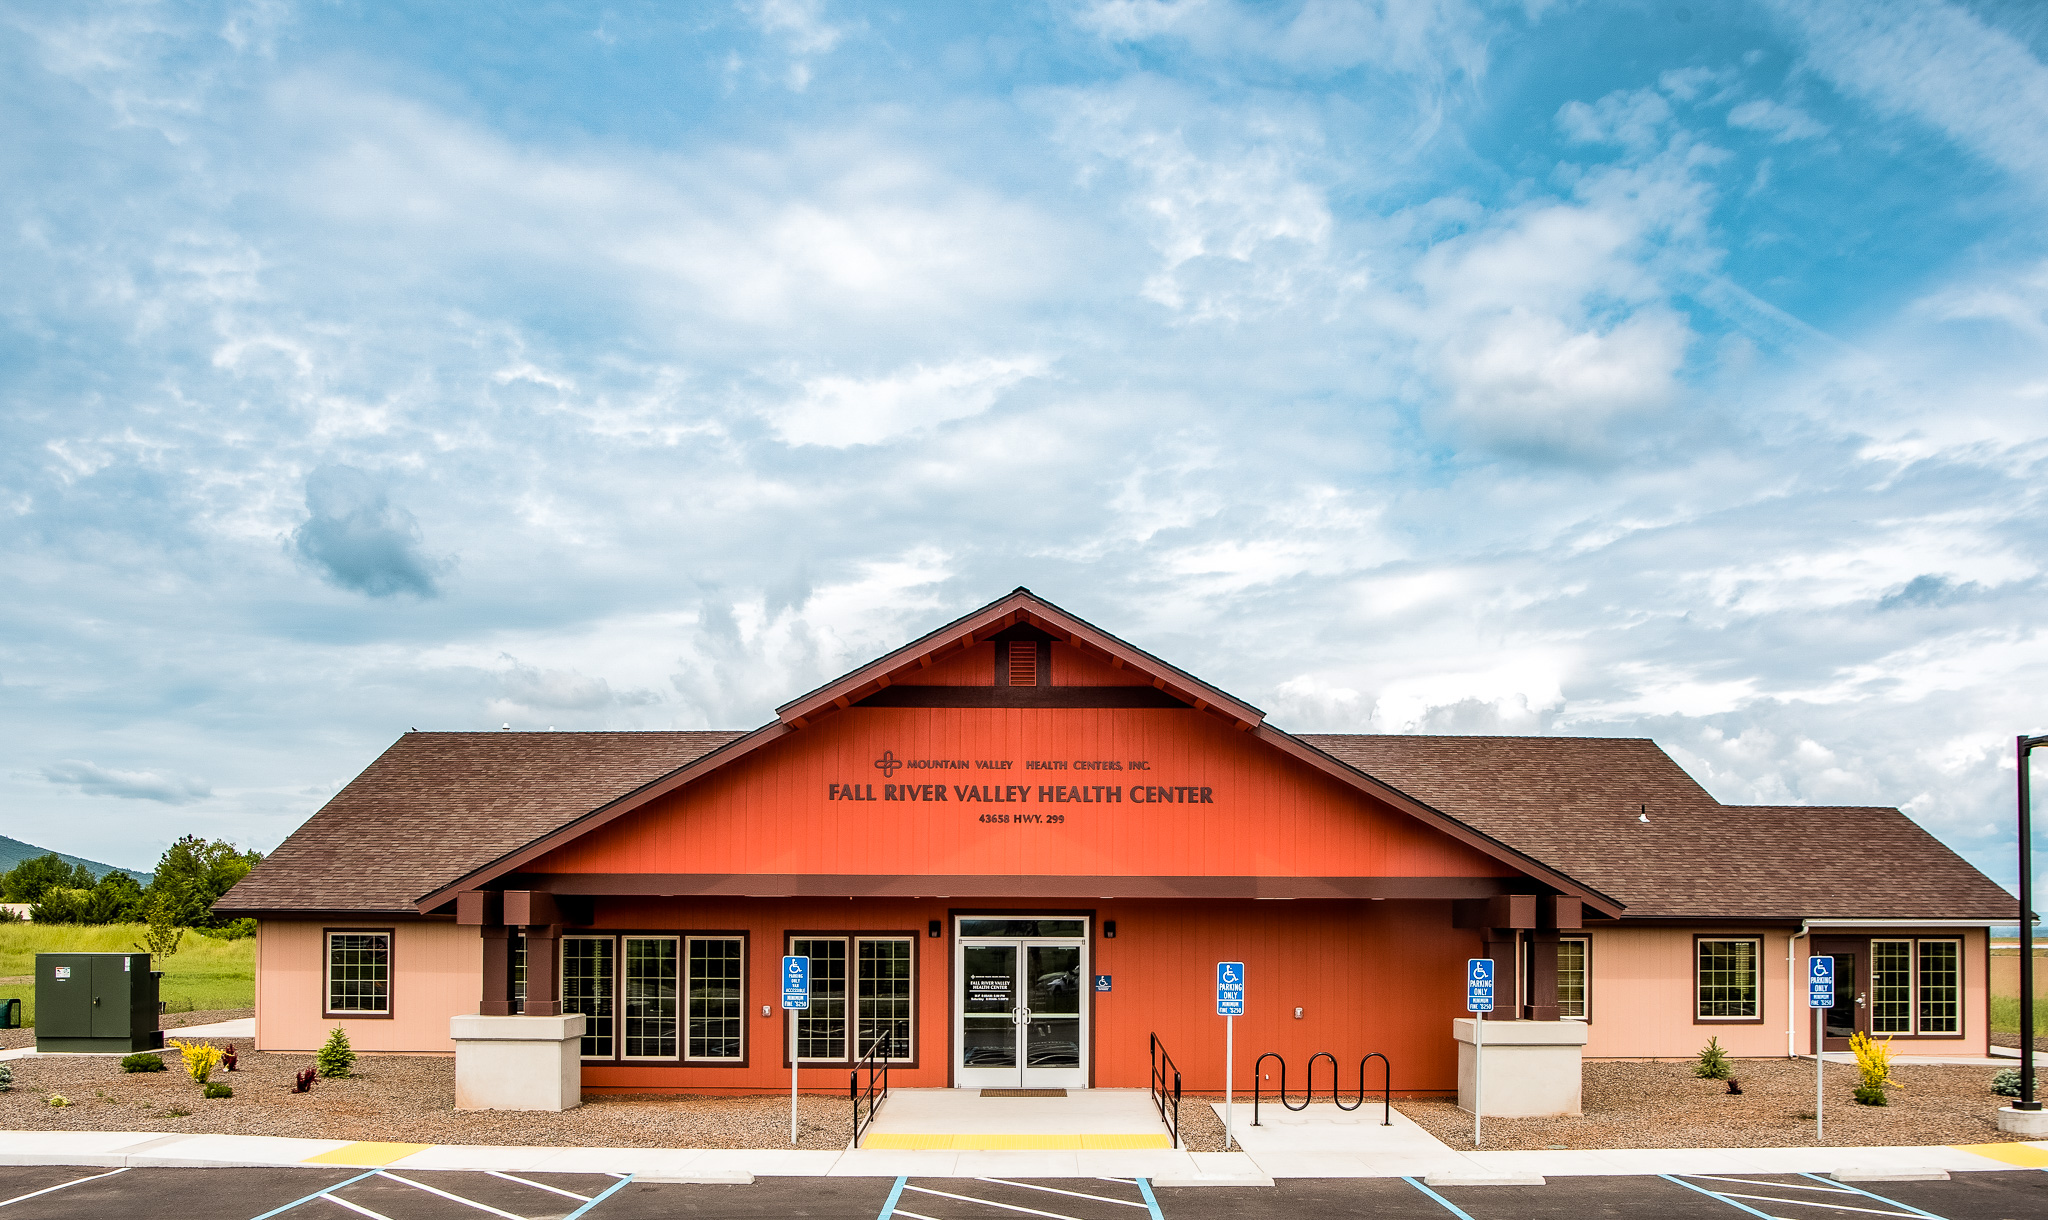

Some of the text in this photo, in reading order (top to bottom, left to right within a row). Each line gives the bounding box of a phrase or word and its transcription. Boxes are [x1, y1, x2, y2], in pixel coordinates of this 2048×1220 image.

[906, 760, 1151, 772] MOUNTAIN VALLEY HEALTH CENTERS, INC.
[828, 783, 1214, 804] FALL RIVER VALLEY HEALTH CENTER
[978, 814, 1065, 824] 43658 HWY. 299
